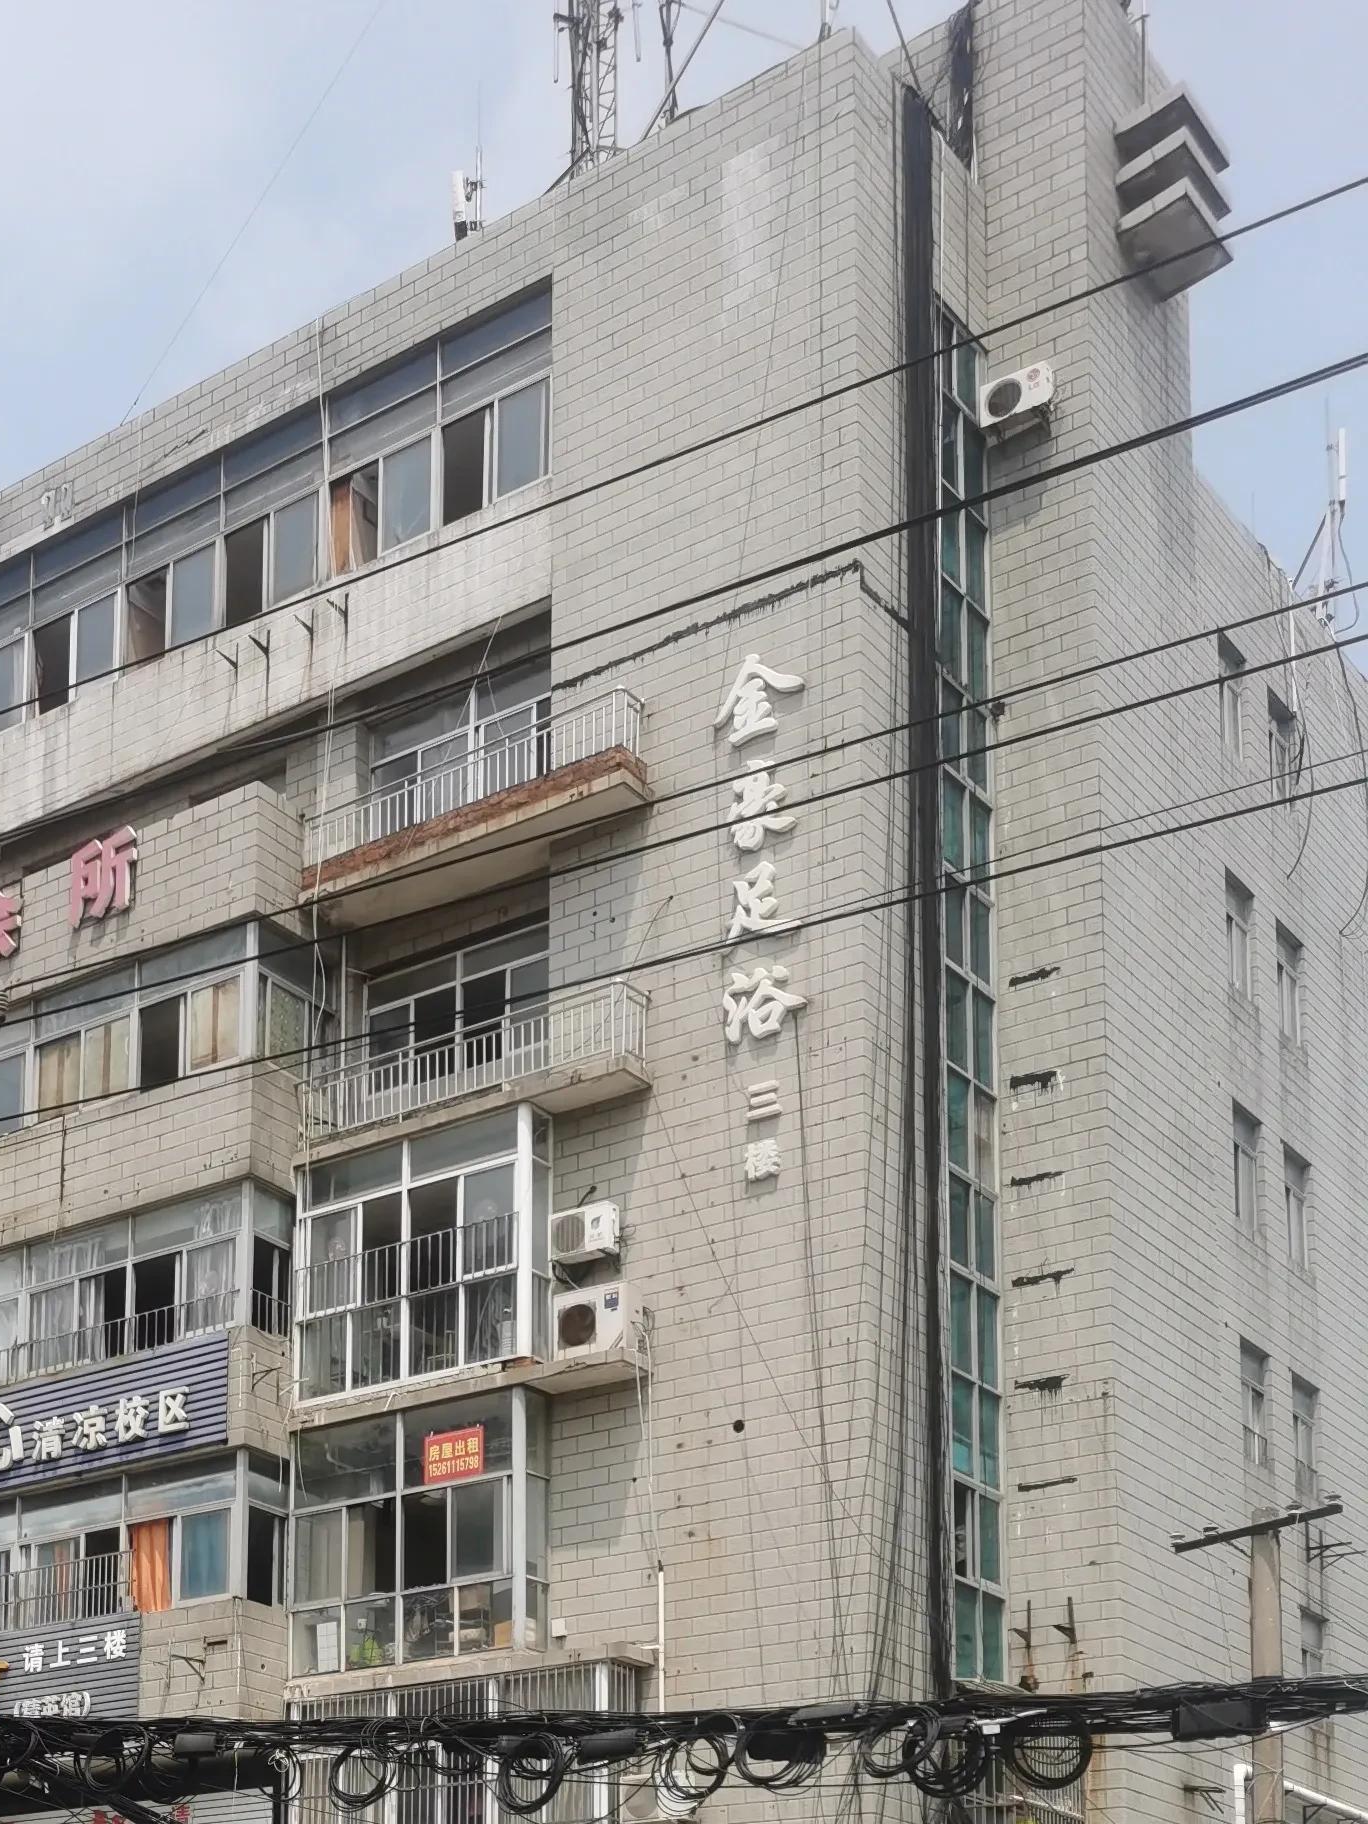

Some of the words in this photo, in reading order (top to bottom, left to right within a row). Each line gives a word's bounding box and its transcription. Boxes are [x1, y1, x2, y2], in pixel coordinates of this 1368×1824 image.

[32, 1386, 195, 1462] 清凉校区
[428, 1437, 480, 1463] 房屋出租
[428, 1455, 480, 1478] 15261115798
[22, 1629, 128, 1674] 请上三楼
